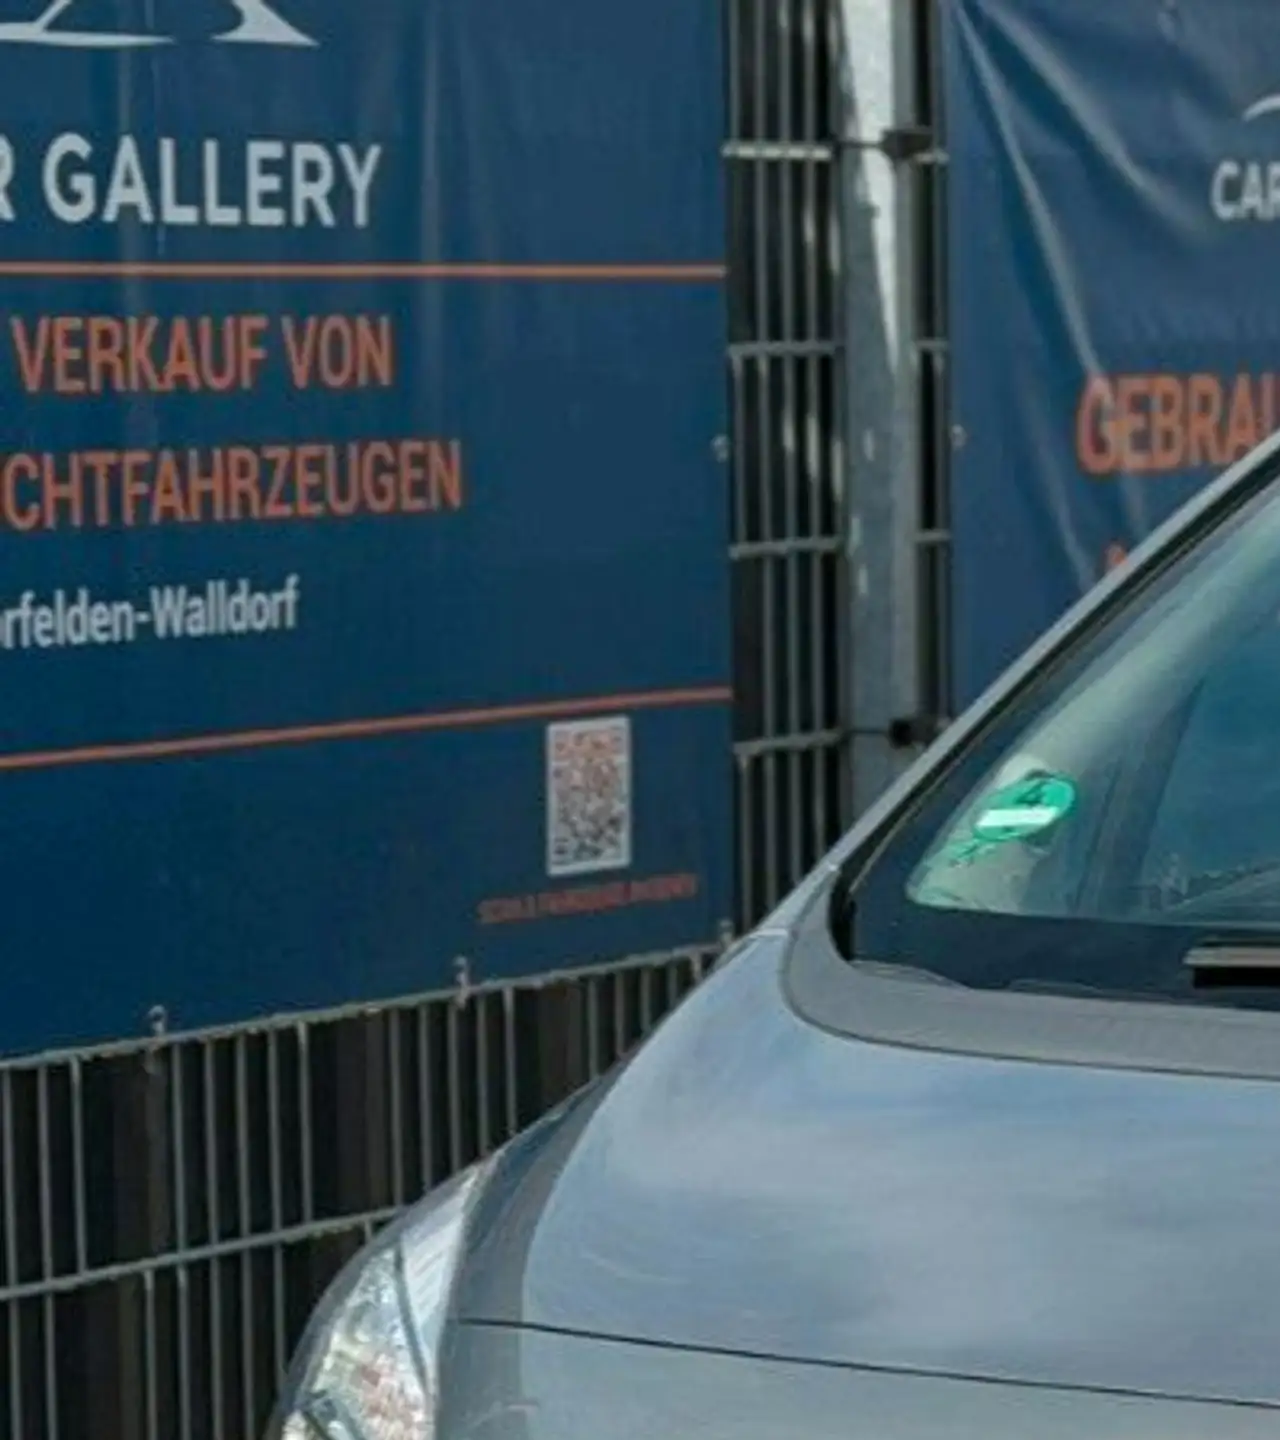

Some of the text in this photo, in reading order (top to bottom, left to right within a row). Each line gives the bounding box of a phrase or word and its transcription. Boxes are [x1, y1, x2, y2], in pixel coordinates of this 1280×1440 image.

[42, 132, 382, 228] GALLERY
[10, 314, 394, 393] VERKAUF VON
[3, 439, 462, 531] CHTFAHRZEUGEN
[0, 573, 300, 649] rfelden-Walldorf
